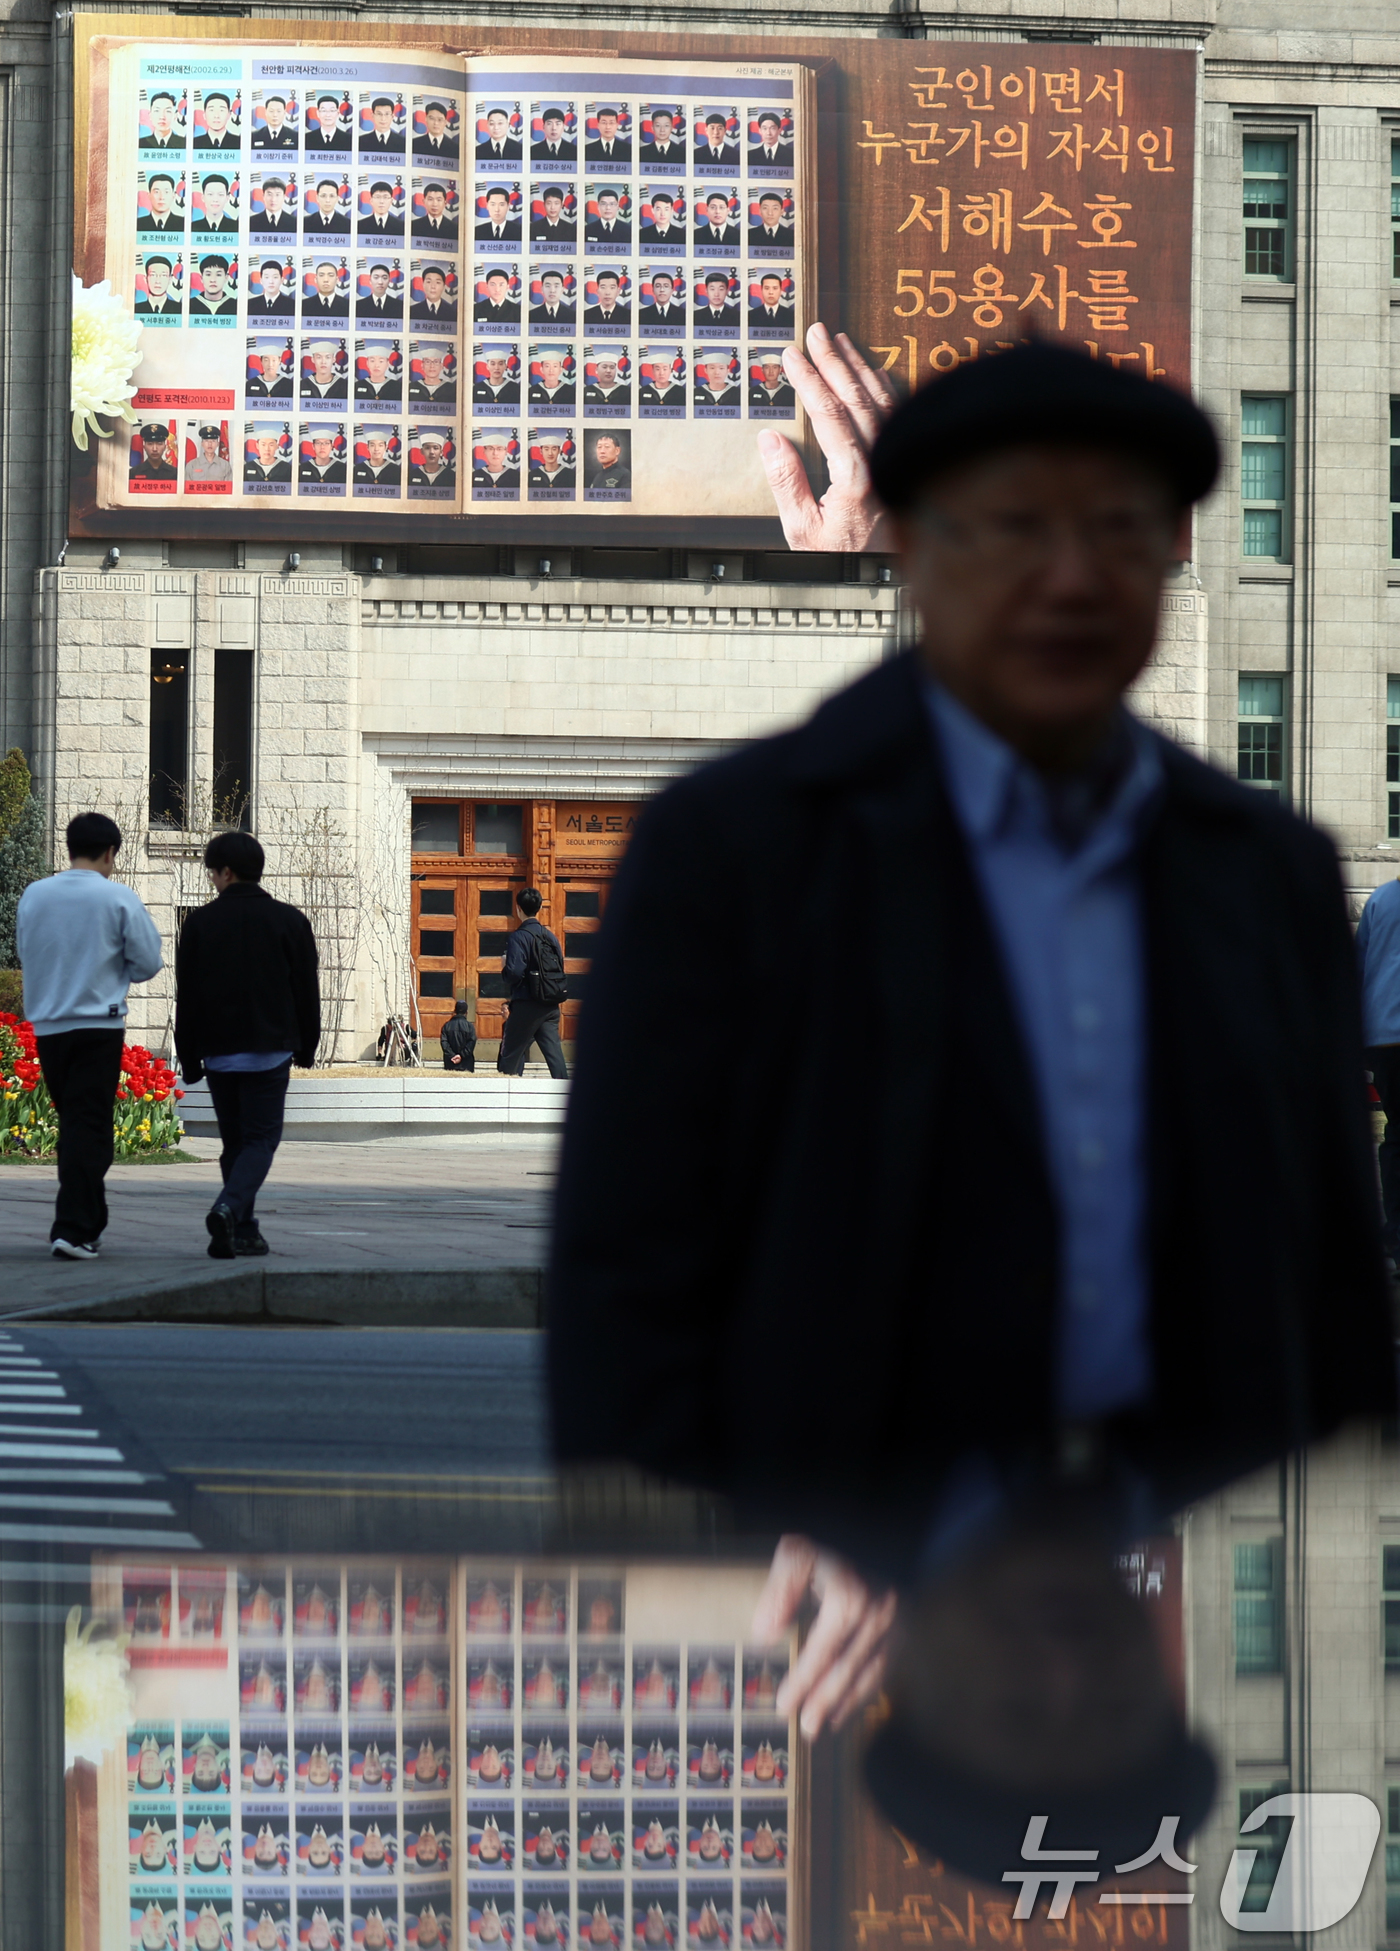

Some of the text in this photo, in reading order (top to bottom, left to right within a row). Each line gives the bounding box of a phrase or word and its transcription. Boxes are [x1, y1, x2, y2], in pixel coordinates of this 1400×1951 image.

[260, 64, 284, 76] 천안함
[908, 65, 1124, 117] 군인이면서
[856, 120, 1176, 174] 누군가의 자식인
[385, 238, 397, 246] 상사
[897, 186, 1138, 256] 서해수호
[893, 262, 1138, 332] 55용사를
[138, 394, 162, 404] 연평도
